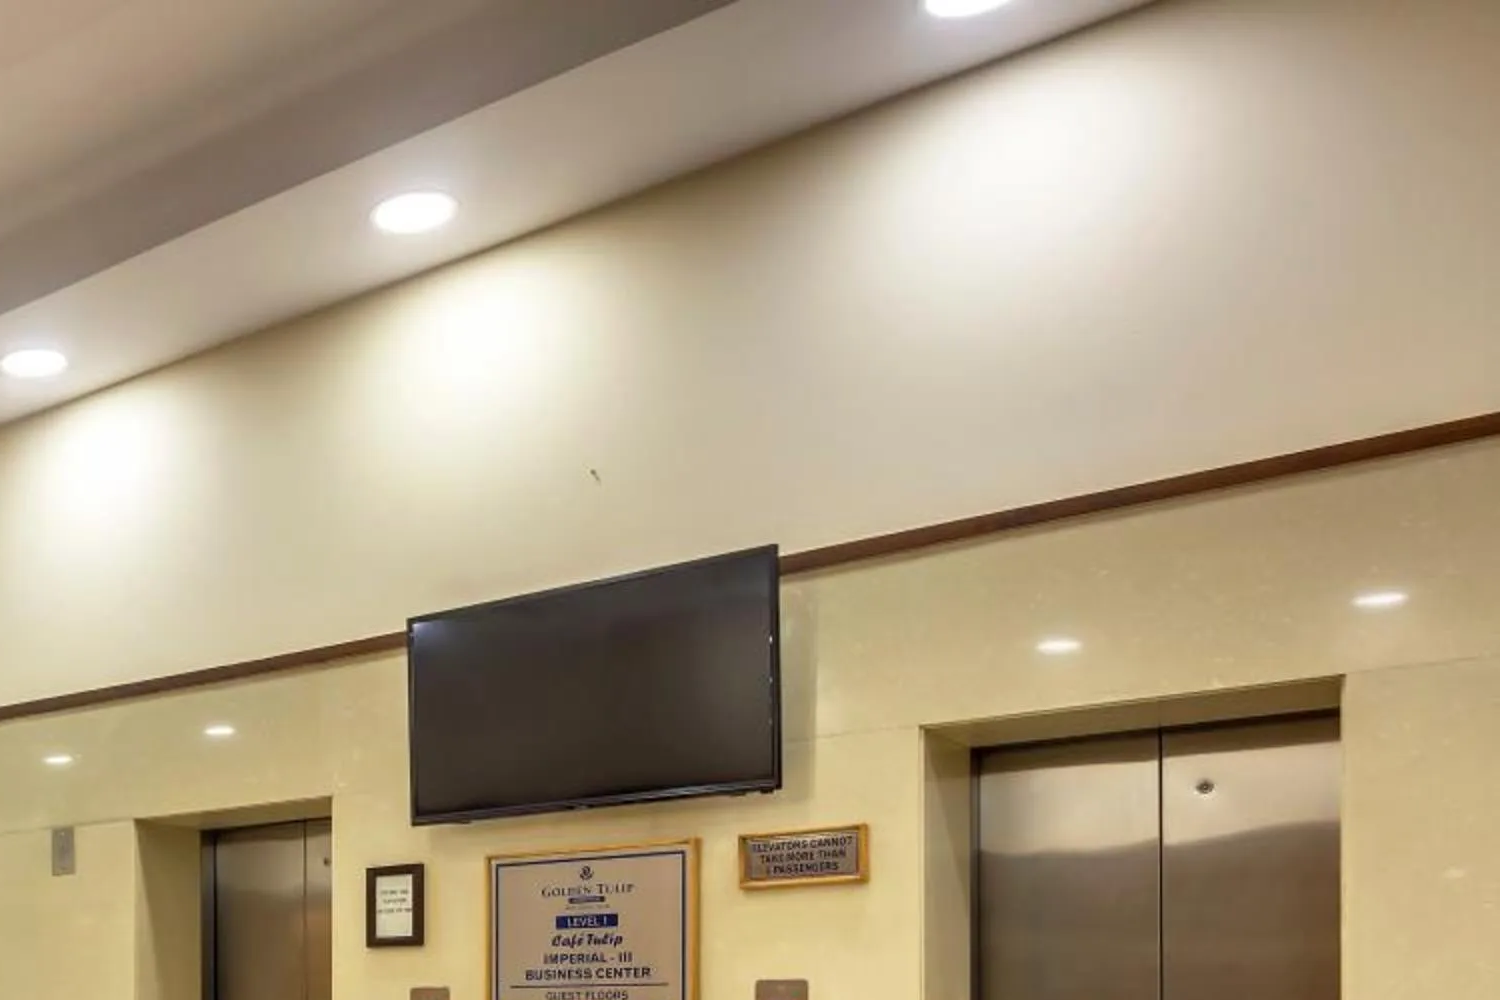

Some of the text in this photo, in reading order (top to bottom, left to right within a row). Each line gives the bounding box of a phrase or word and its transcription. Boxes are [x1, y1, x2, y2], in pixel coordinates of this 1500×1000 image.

[810, 836, 853, 849] CANNOT
[567, 915, 600, 927] LEVEL
[543, 952, 608, 965] IMPERIAL
[525, 967, 651, 981] BUSINESS CENTER
[545, 989, 629, 1000] GUEST FLOORS
